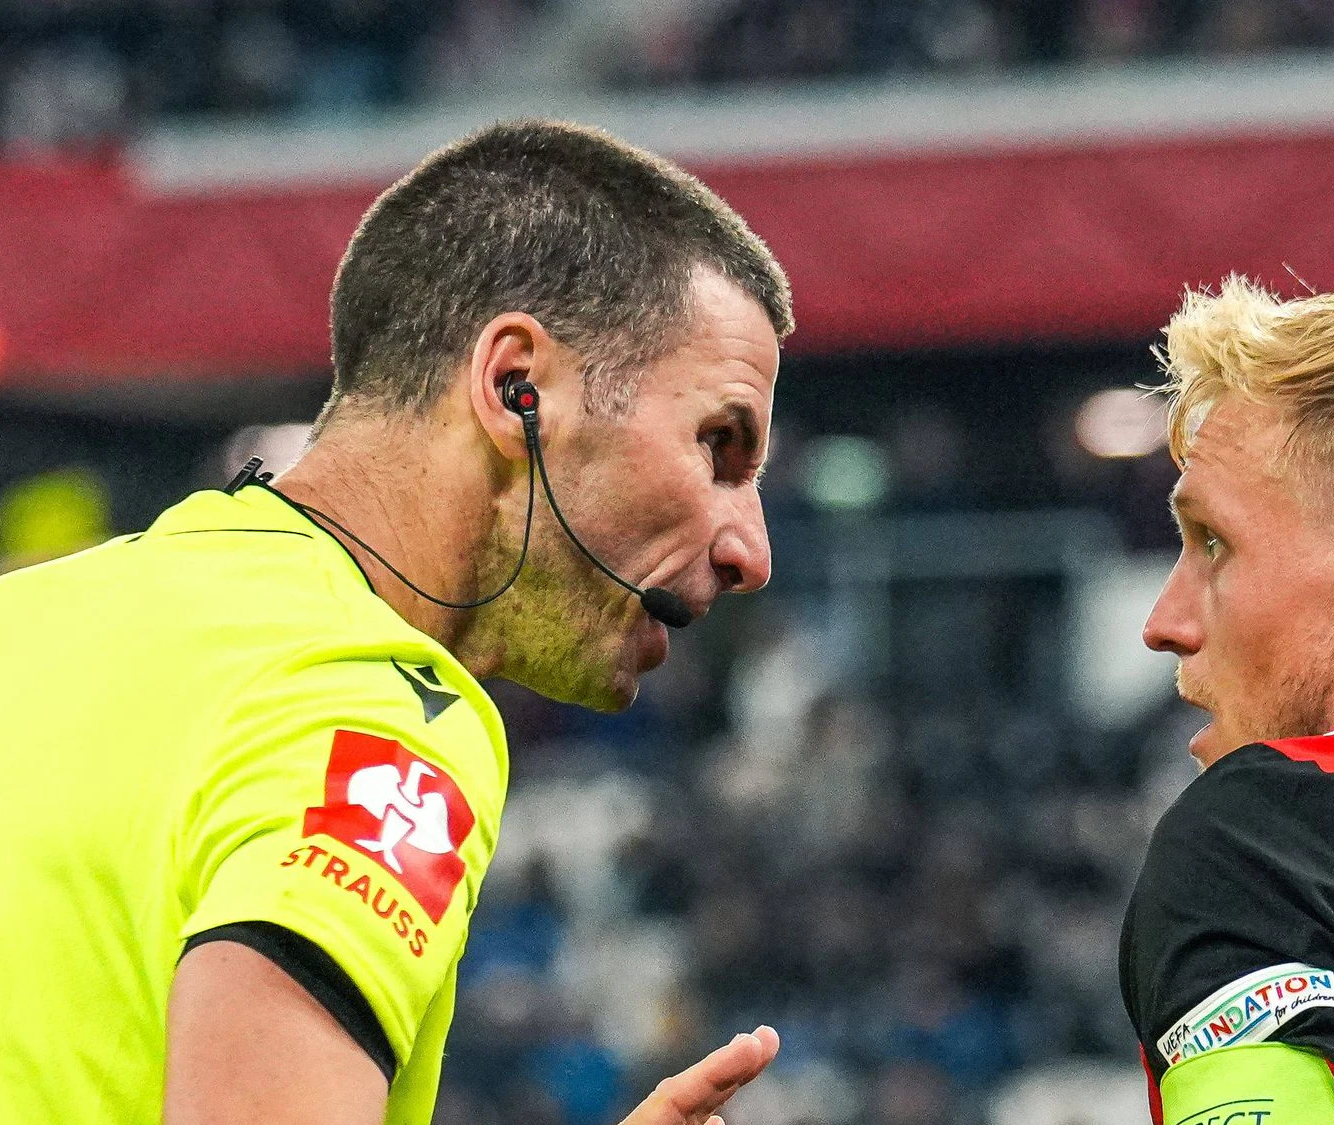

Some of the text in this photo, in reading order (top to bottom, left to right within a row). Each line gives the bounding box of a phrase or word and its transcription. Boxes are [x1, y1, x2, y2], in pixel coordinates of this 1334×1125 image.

[280, 845, 429, 958] STRAUSS
[1274, 993, 1334, 1026] for children
[1162, 1022, 1191, 1056] UEFA
